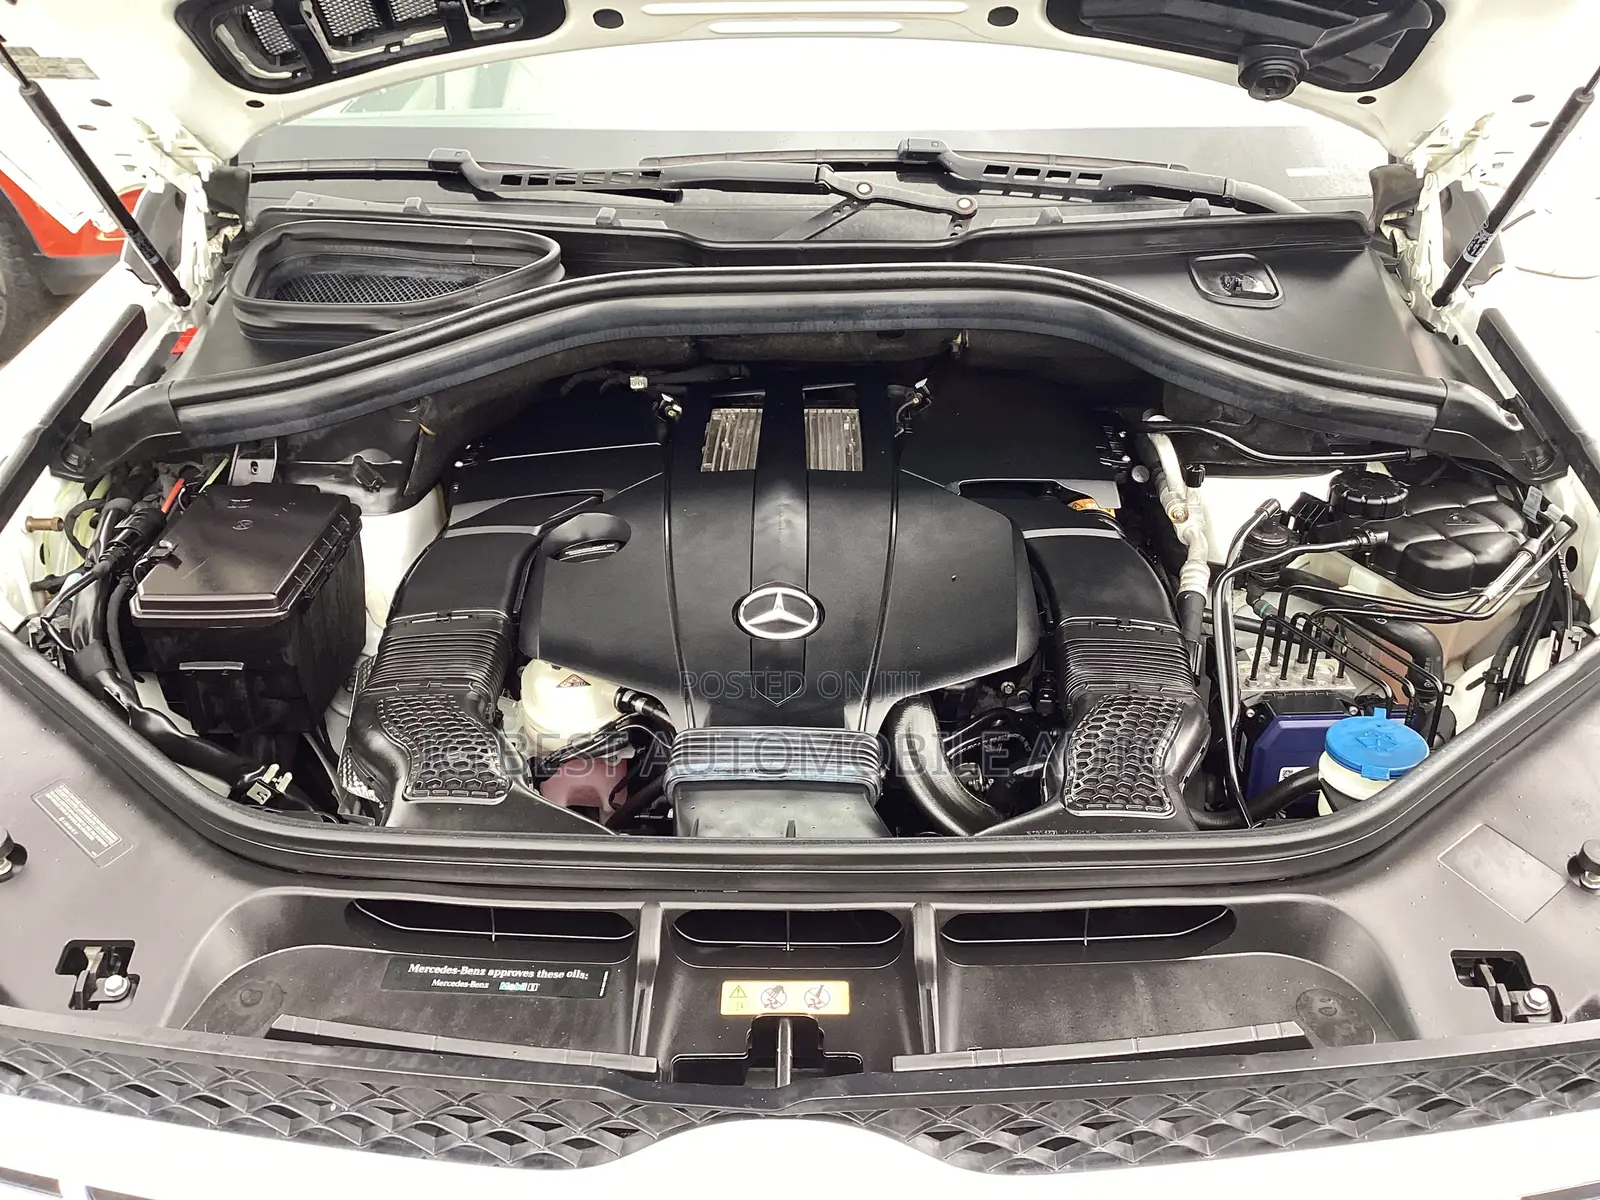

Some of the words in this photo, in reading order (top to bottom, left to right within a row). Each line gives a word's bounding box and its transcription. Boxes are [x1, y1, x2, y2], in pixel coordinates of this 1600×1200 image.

[407, 963, 486, 976] Mercedes-Benz
[488, 969, 534, 979] approves
[536, 969, 565, 979] these
[566, 969, 589, 980] oils:
[431, 978, 490, 989] Mercedes-Benz
